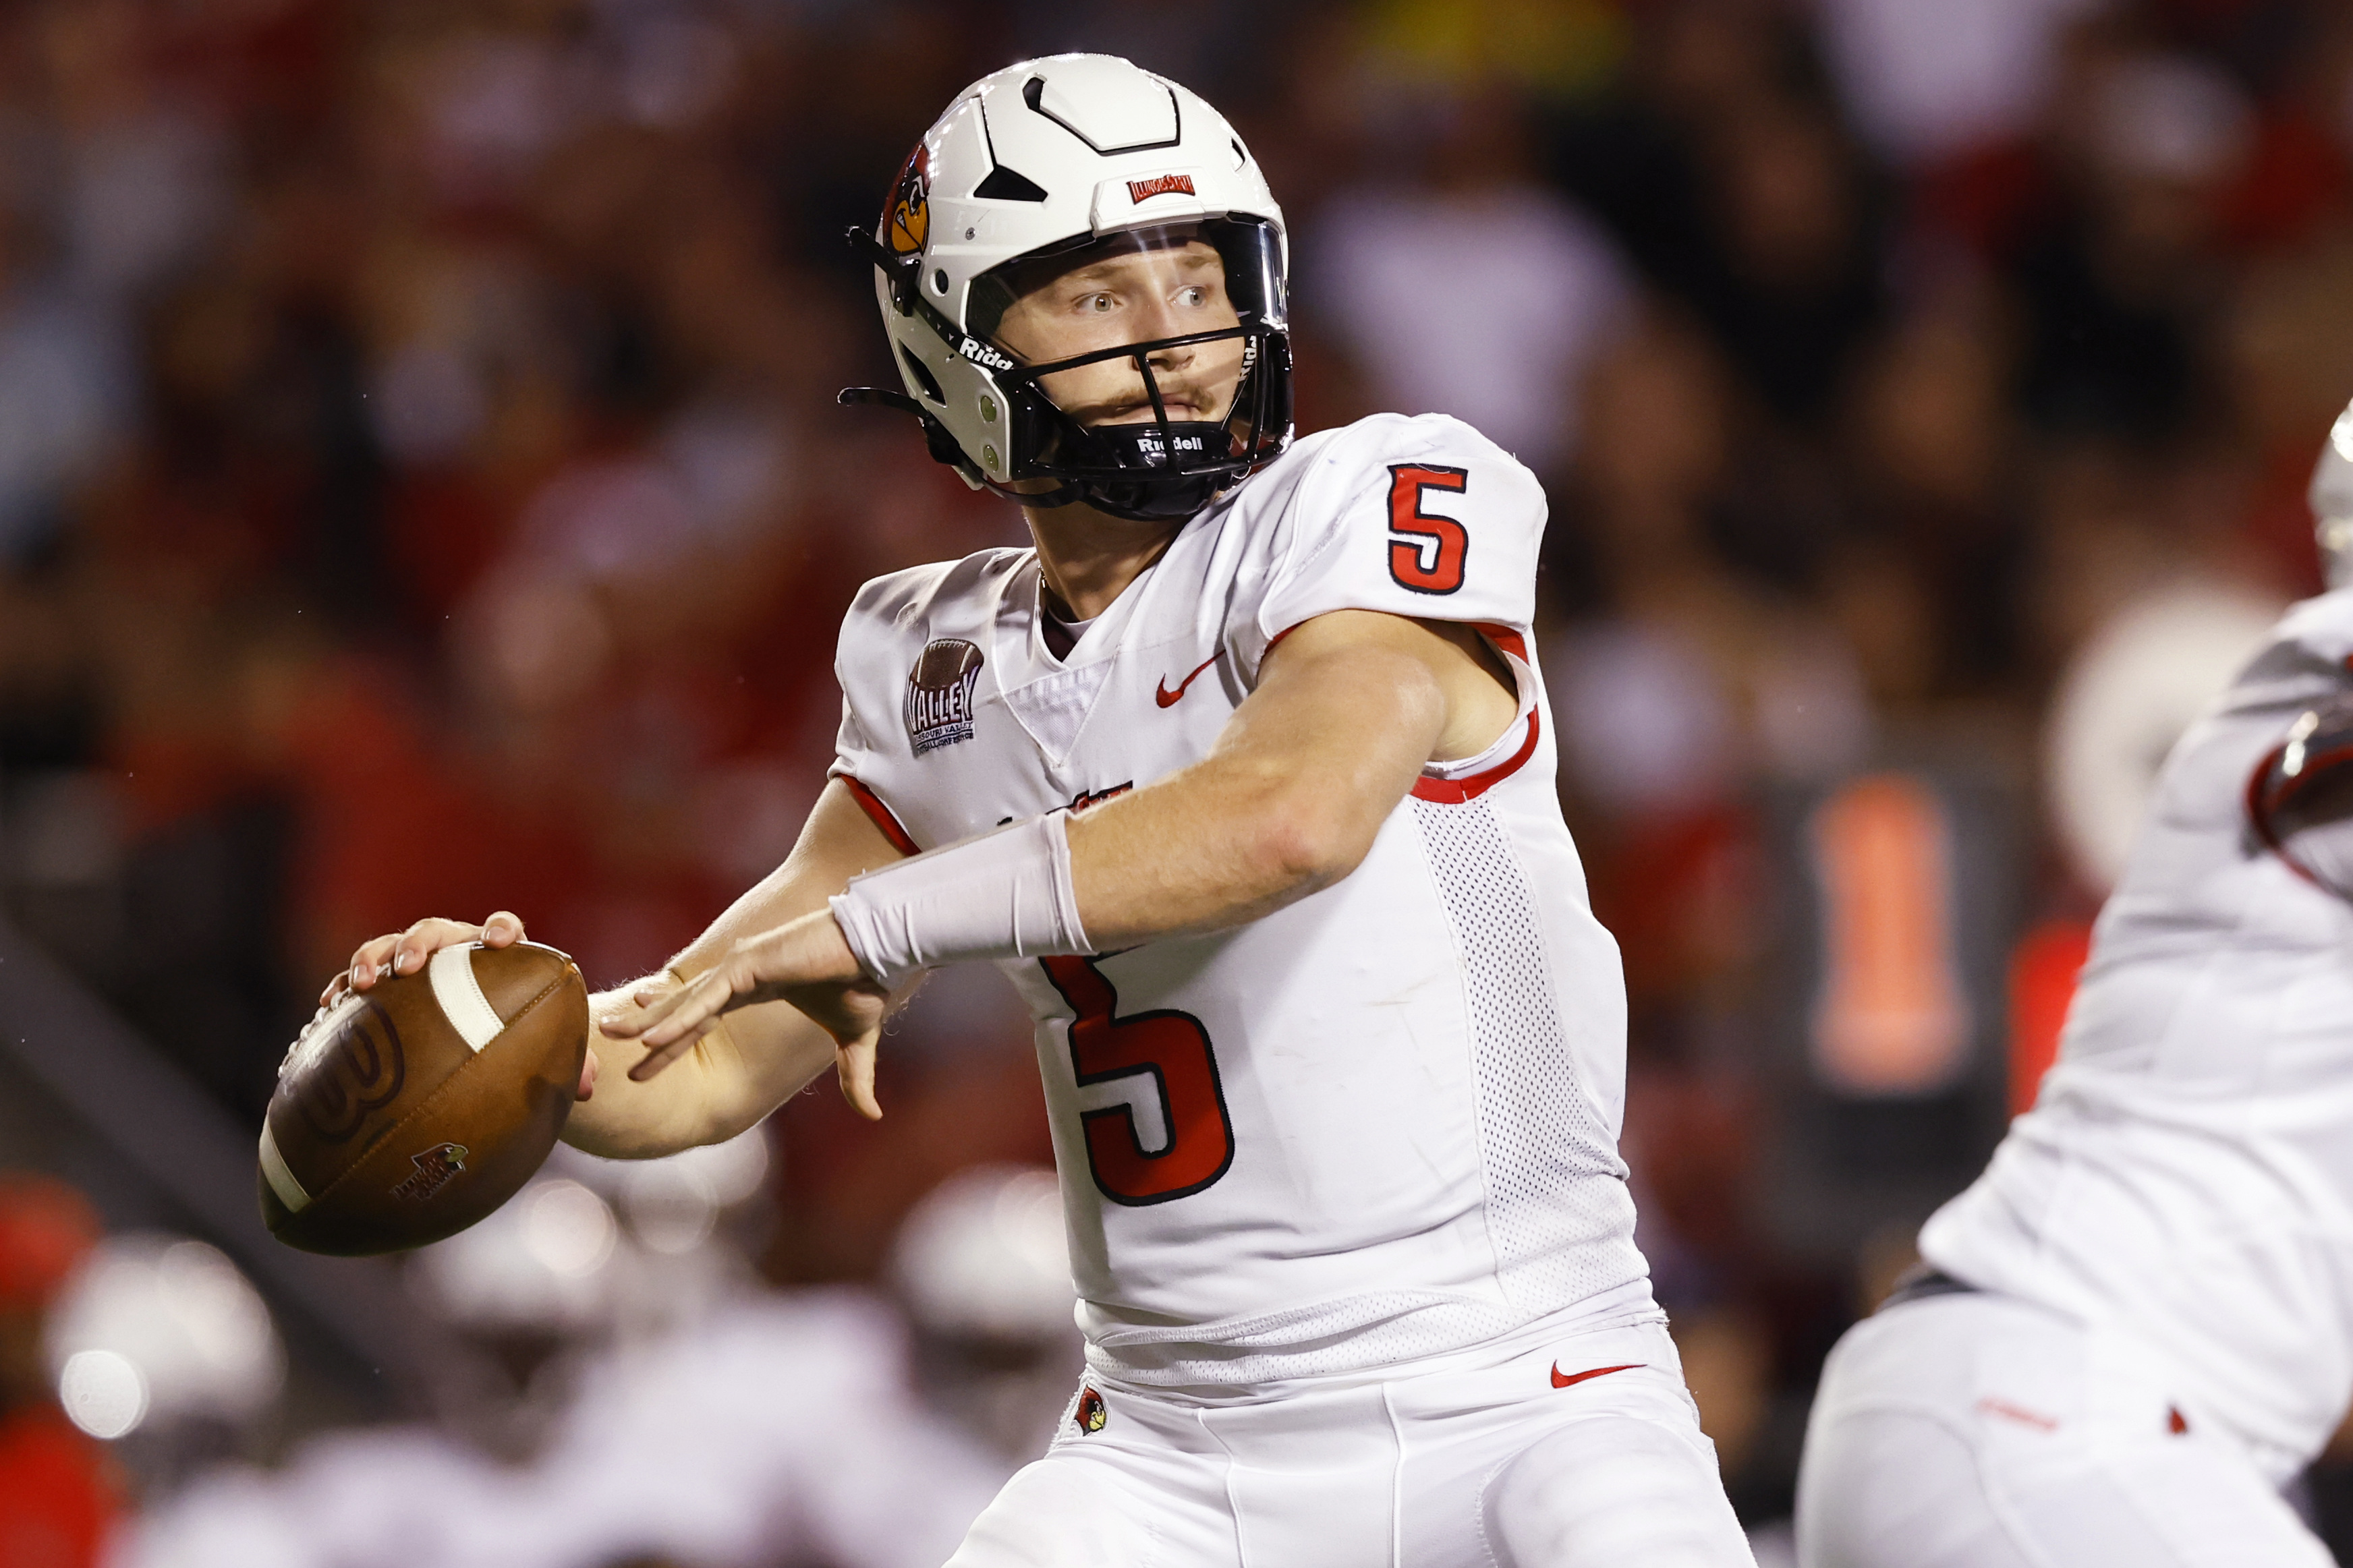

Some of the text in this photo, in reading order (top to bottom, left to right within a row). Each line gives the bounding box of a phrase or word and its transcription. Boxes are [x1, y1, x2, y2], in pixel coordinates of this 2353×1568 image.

[959, 337, 1013, 370] Ridd
[1386, 463, 1469, 596] 5
[906, 664, 980, 735] VALLEY
[1038, 944, 1235, 1207] 5
